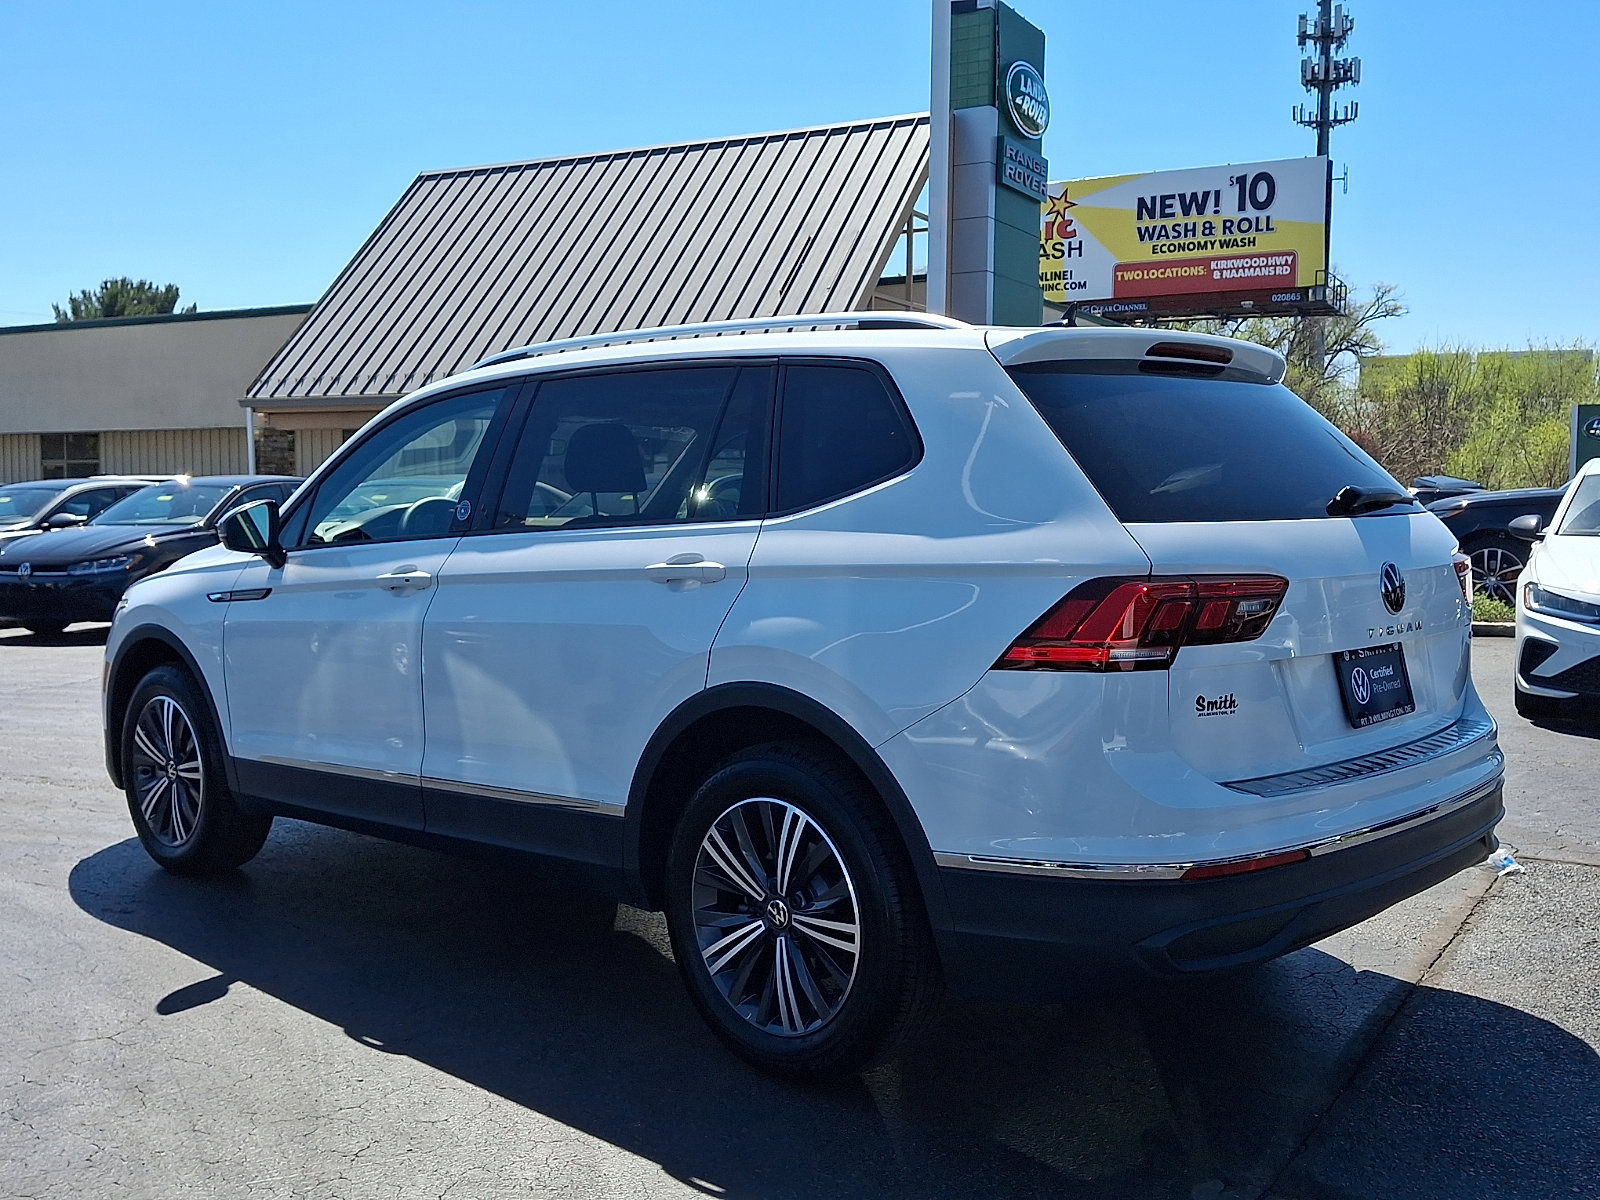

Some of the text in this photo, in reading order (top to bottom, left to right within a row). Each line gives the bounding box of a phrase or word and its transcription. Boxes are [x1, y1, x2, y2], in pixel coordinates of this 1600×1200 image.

[1020, 74, 1043, 101] LAND
[1021, 95, 1046, 126] ROVER
[1006, 144, 1046, 176] RANGE
[1005, 164, 1047, 196] ROVER
[1136, 190, 1221, 221] NEW!
[1040, 218, 1077, 240] IC
[1136, 215, 1275, 242] WASH & ROLL
[1151, 236, 1256, 255] ECONOMY WASH
[1210, 255, 1294, 270] KIRKWOOD HWY
[1213, 265, 1291, 279] & NAAMANS RD
[1116, 266, 1207, 281] TWO LOCATIONS:
[1368, 620, 1423, 638] TIGUAN
[1369, 665, 1394, 679] Certified
[1373, 679, 1402, 693] Pre-Owned
[1195, 693, 1239, 712] Smith
